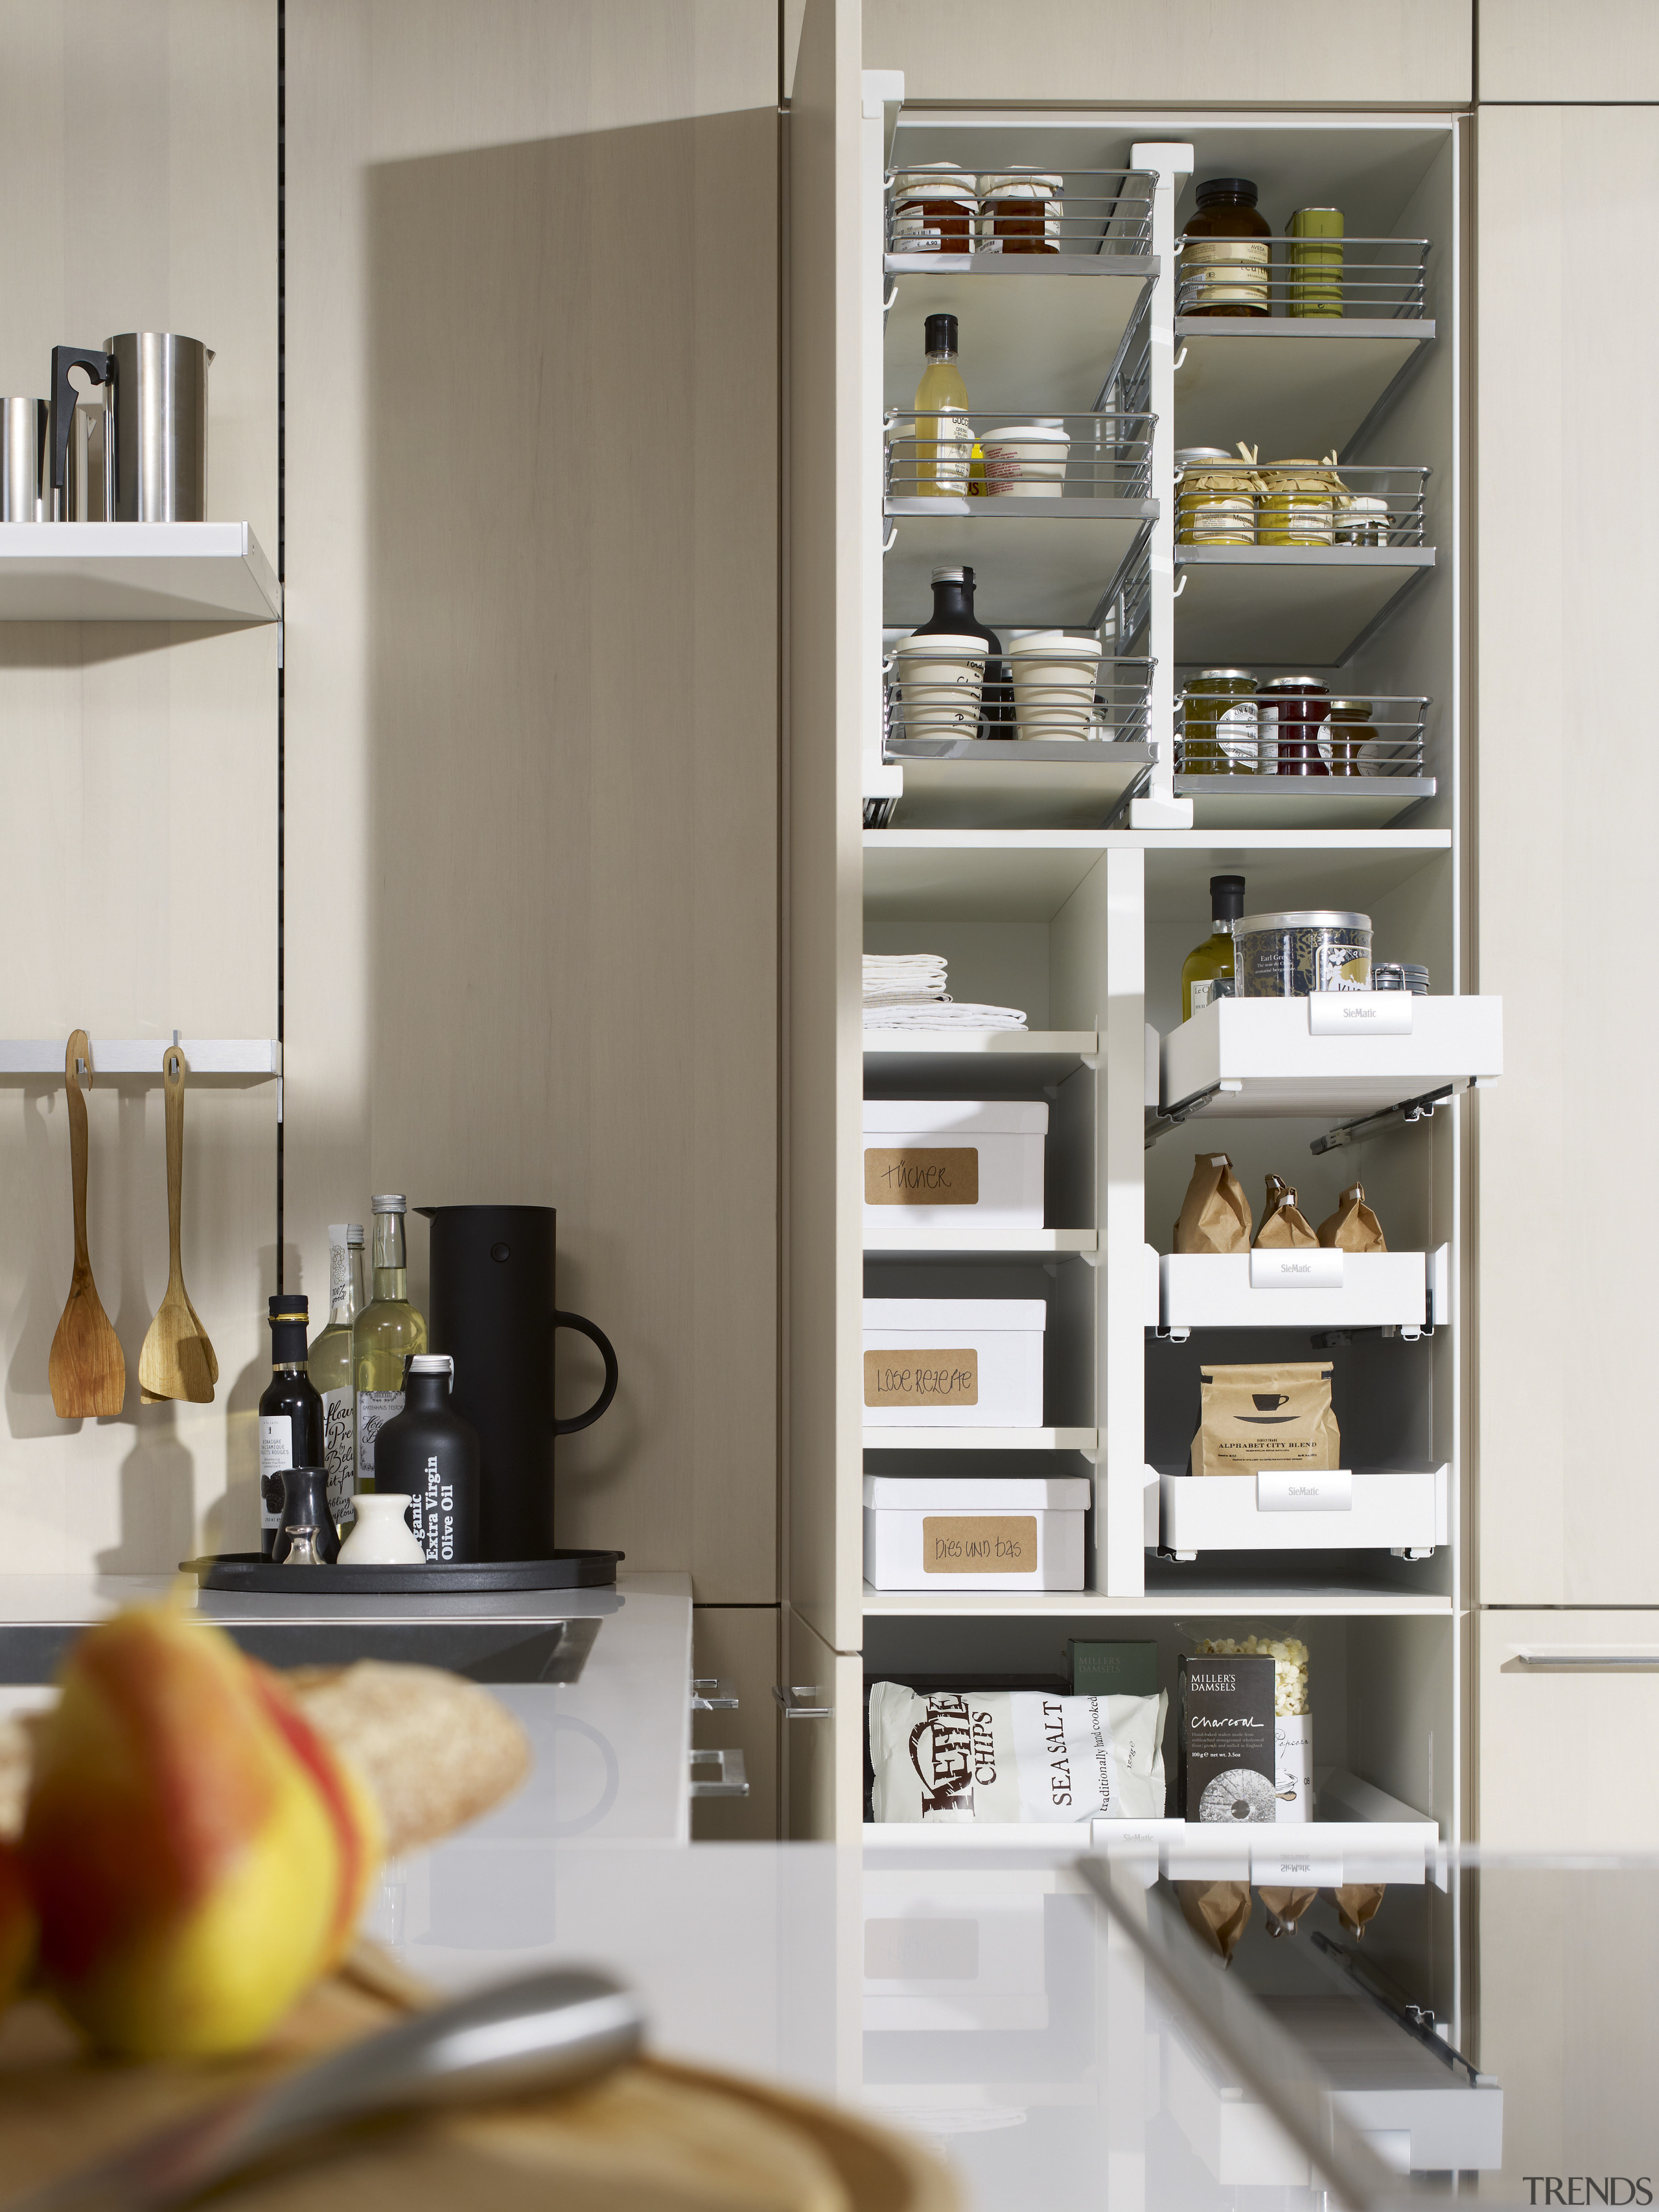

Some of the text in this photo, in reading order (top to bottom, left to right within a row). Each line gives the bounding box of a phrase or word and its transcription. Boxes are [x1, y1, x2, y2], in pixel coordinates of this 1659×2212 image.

[1343, 1008, 1377, 1018] SieMatic
[1281, 1264, 1312, 1273] SieMatic
[331, 1290, 347, 1309] good
[1288, 1487, 1319, 1496] SieMatic
[424, 1456, 441, 1561] Extra Virgin
[441, 1485, 454, 1560] Olive Oil
[1191, 1674, 1236, 1682] MILLER'S
[1191, 1683, 1236, 1692] DAMSELS
[1191, 1716, 1264, 1729] Charcoal
[971, 1711, 997, 1786] CHIPS
[1275, 1728, 1310, 1759] Popcorn
[910, 1694, 975, 1819] KETTLE
[1042, 1701, 1073, 1806] SEA SALT
[1087, 1695, 1110, 1812] traditionally hand cooked
[1123, 1834, 1154, 1843] SieMatic
